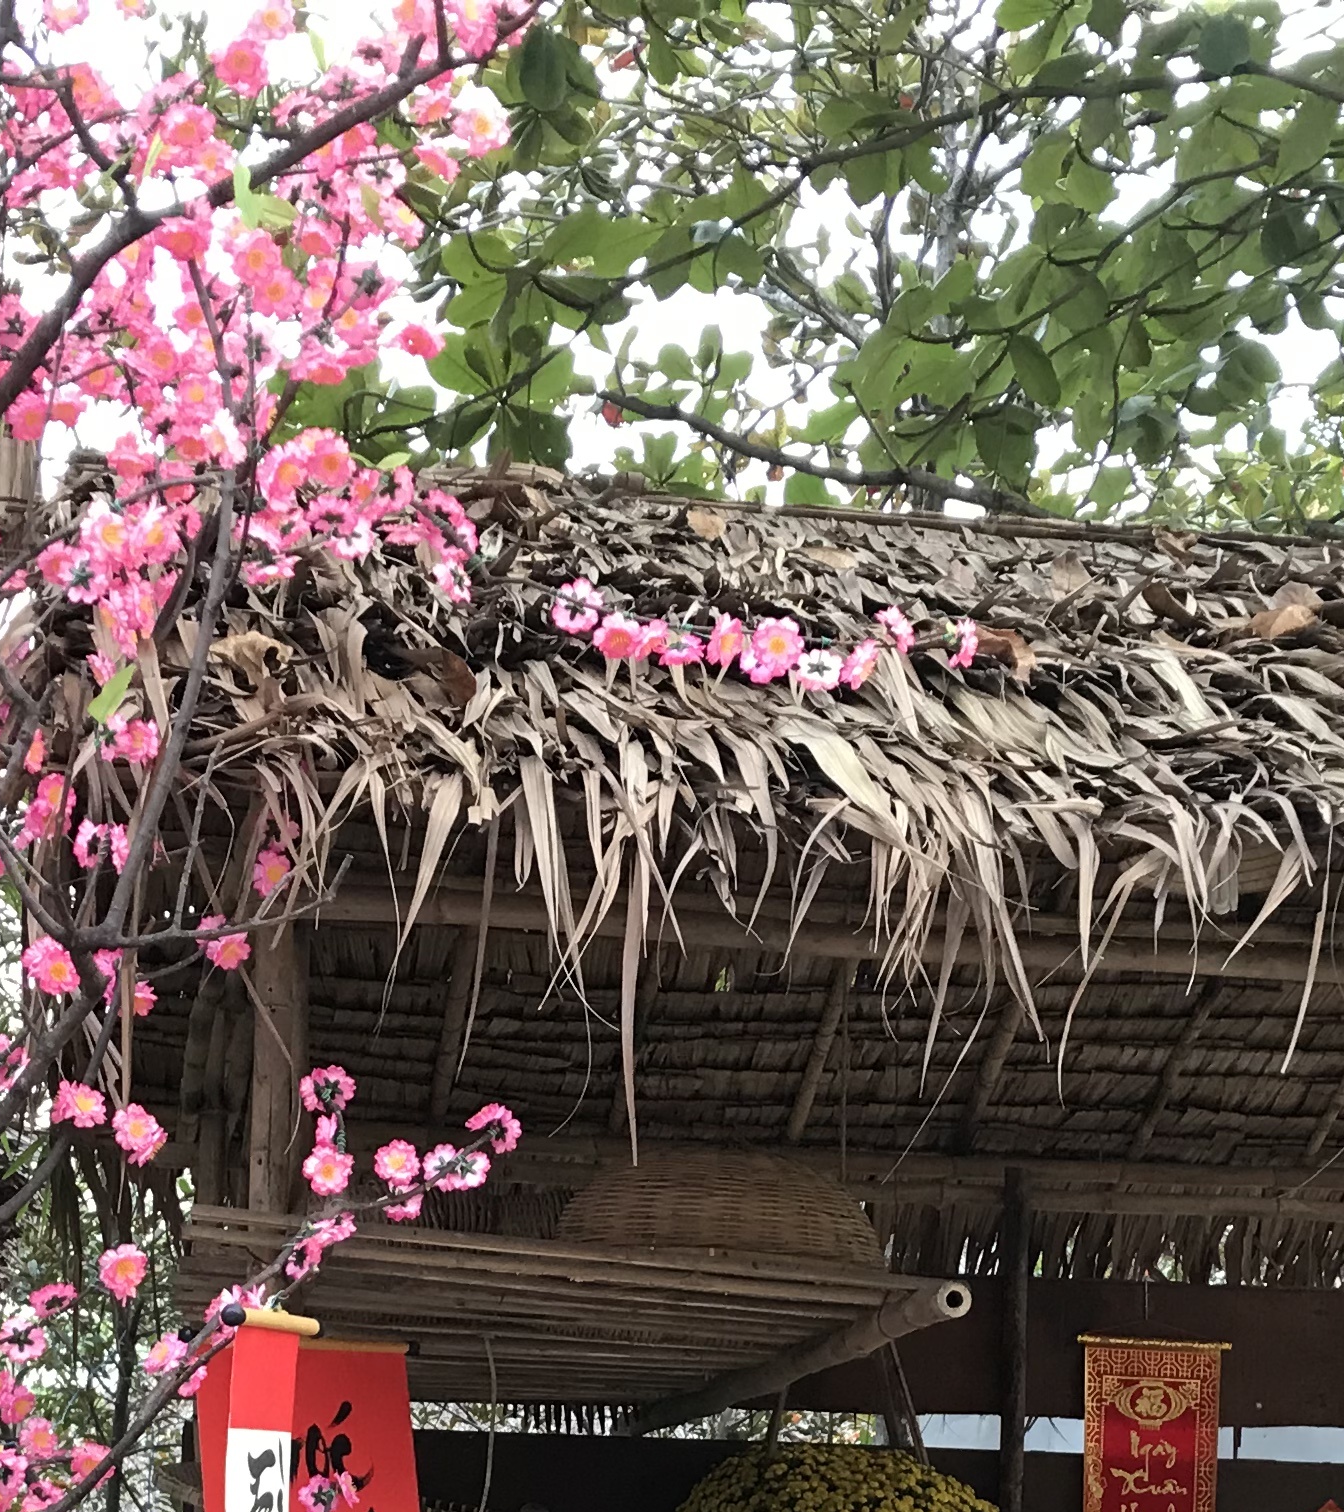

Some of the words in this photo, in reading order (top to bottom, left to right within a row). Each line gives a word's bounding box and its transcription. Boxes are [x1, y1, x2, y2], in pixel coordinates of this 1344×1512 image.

[291, 1401, 374, 1492] óc
[1130, 1430, 1178, 1482] Ngày
[1110, 1467, 1188, 1495] Xuân
